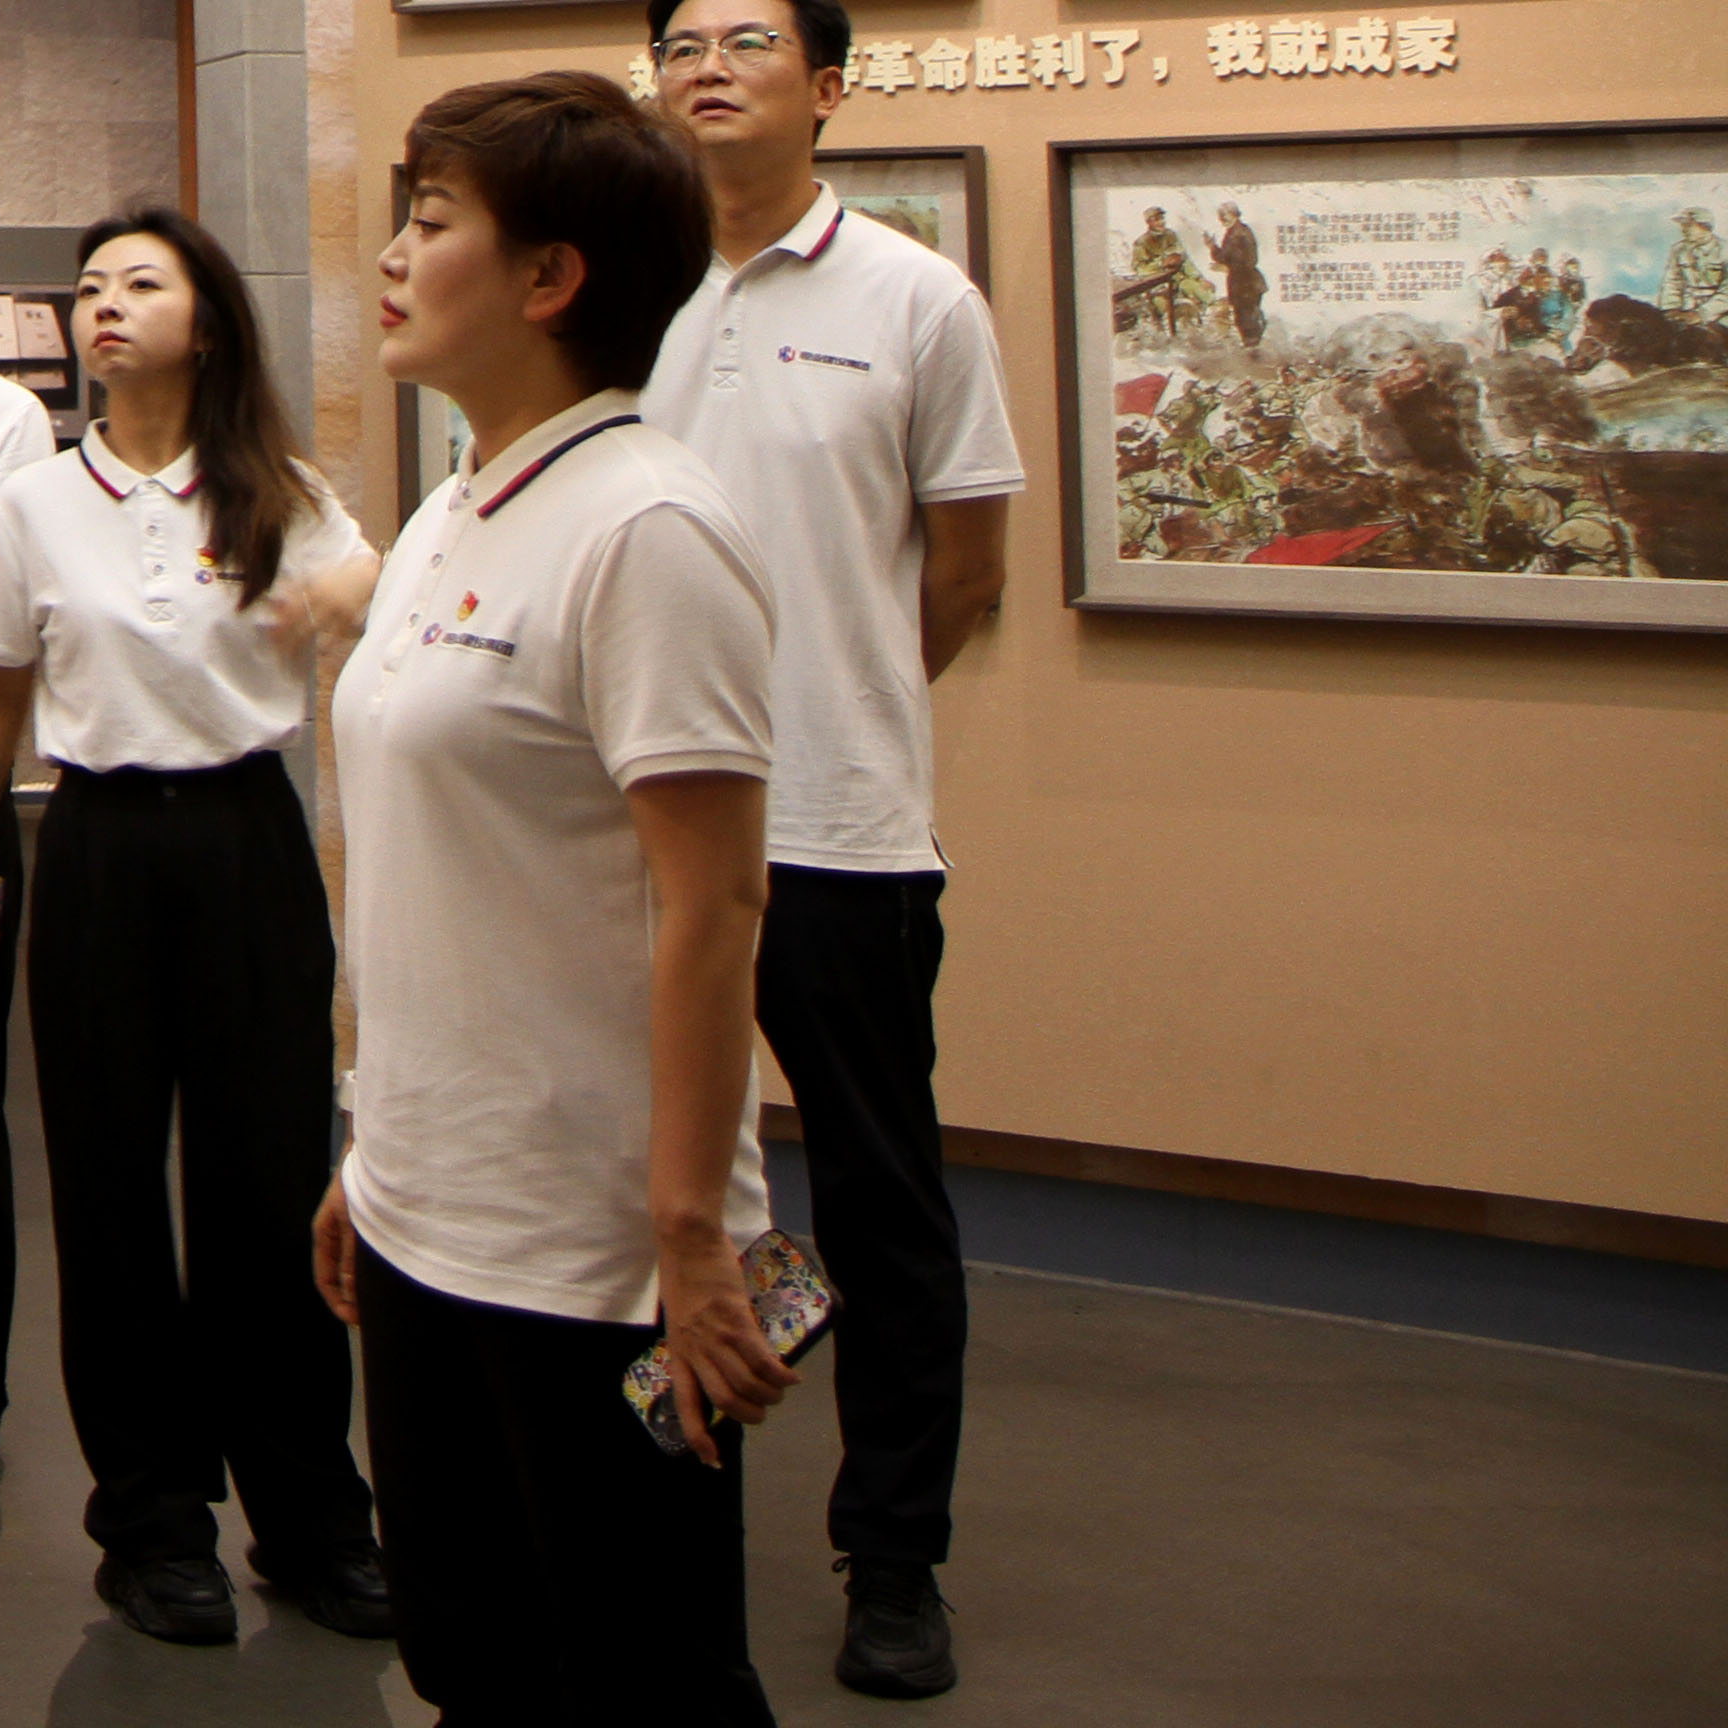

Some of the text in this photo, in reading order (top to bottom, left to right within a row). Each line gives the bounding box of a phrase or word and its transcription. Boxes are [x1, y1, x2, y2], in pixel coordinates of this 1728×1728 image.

[843, 17, 1458, 97] 革命胜利了，我就成家
